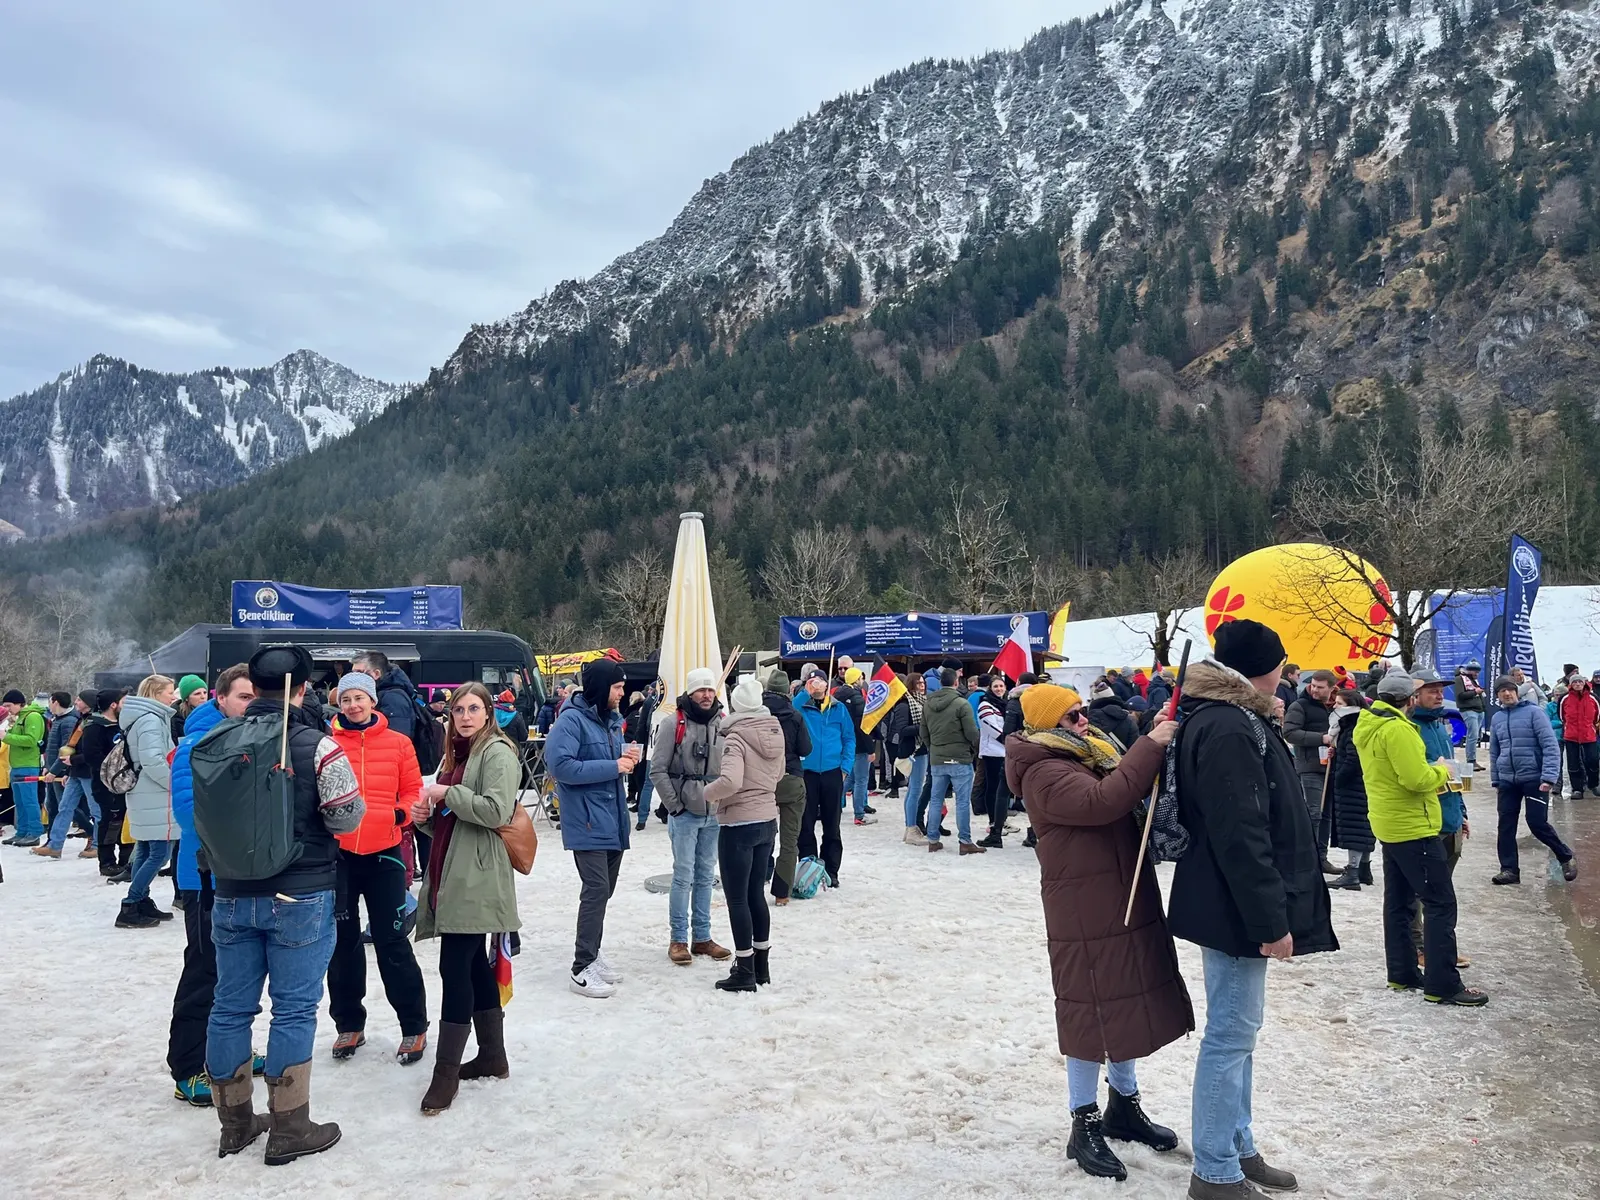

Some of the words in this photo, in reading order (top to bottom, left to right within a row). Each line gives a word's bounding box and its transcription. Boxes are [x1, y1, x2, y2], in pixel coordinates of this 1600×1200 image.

[237, 608, 295, 623] Benediktiner
[785, 641, 832, 654] Benediktiner
[997, 635, 1044, 647] Beiner
